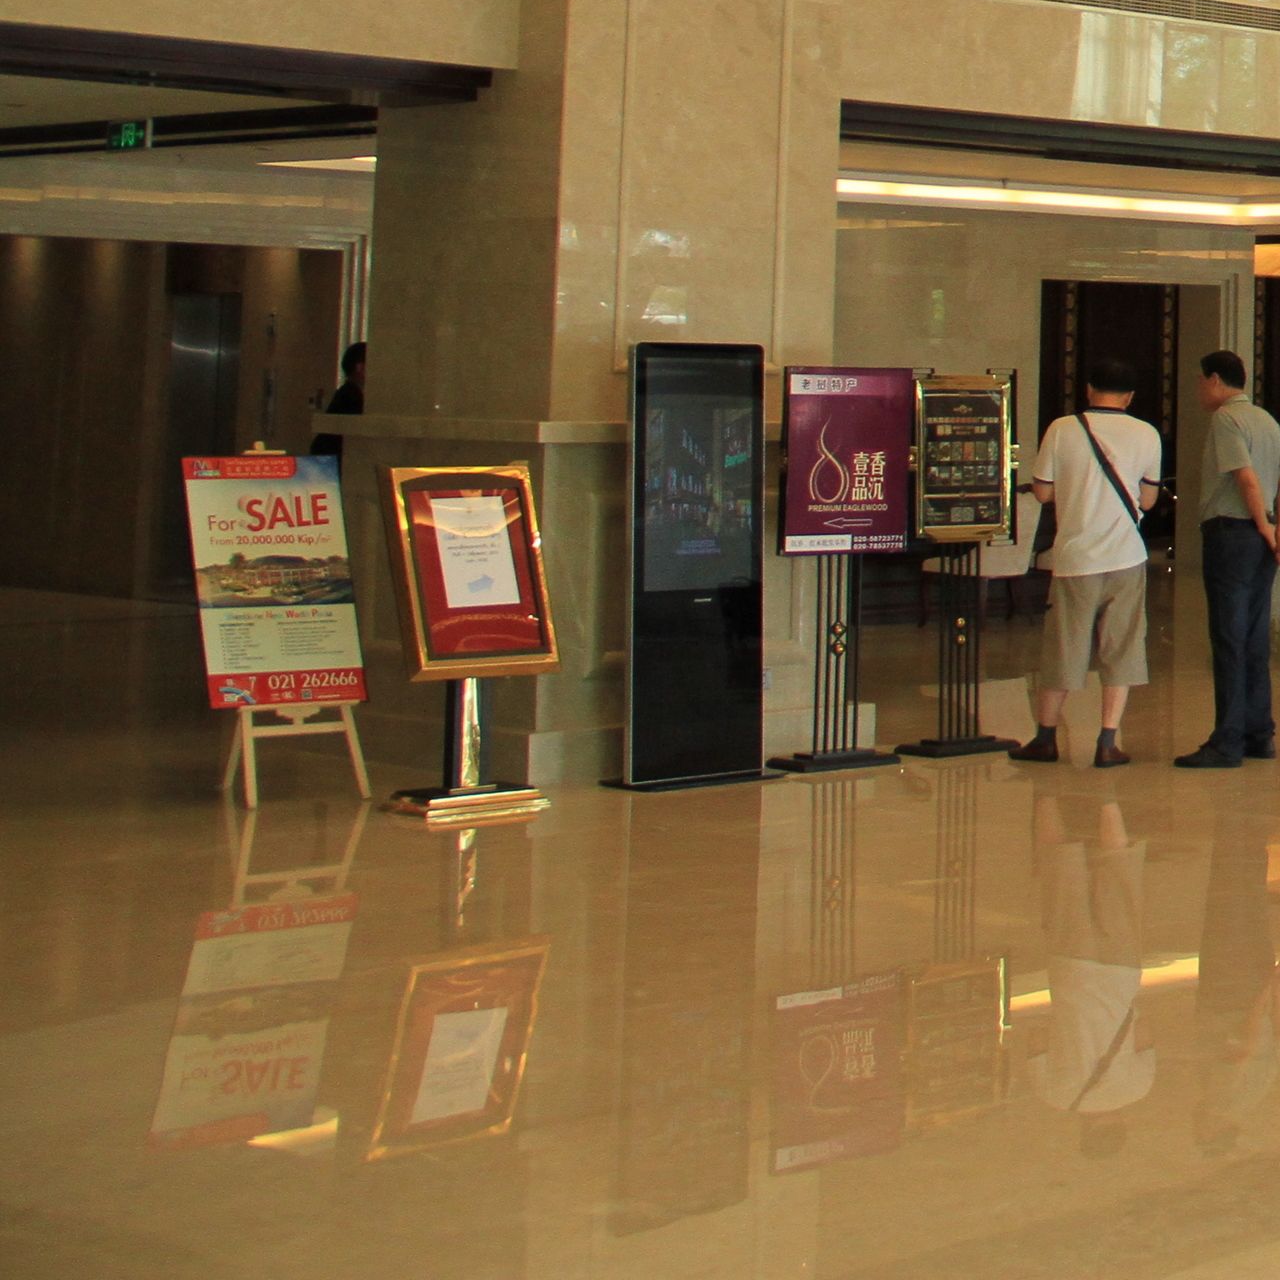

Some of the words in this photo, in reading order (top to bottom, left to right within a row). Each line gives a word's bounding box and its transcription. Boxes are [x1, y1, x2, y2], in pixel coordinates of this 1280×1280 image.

[207, 515, 236, 532] For
[246, 493, 329, 532] SALE
[808, 504, 841, 512] PREMIUM
[842, 503, 888, 512] EAGLEWOOD
[210, 535, 233, 545] From
[236, 534, 295, 546] 20,000,000
[268, 674, 295, 690] 021
[301, 672, 358, 688] 262666
